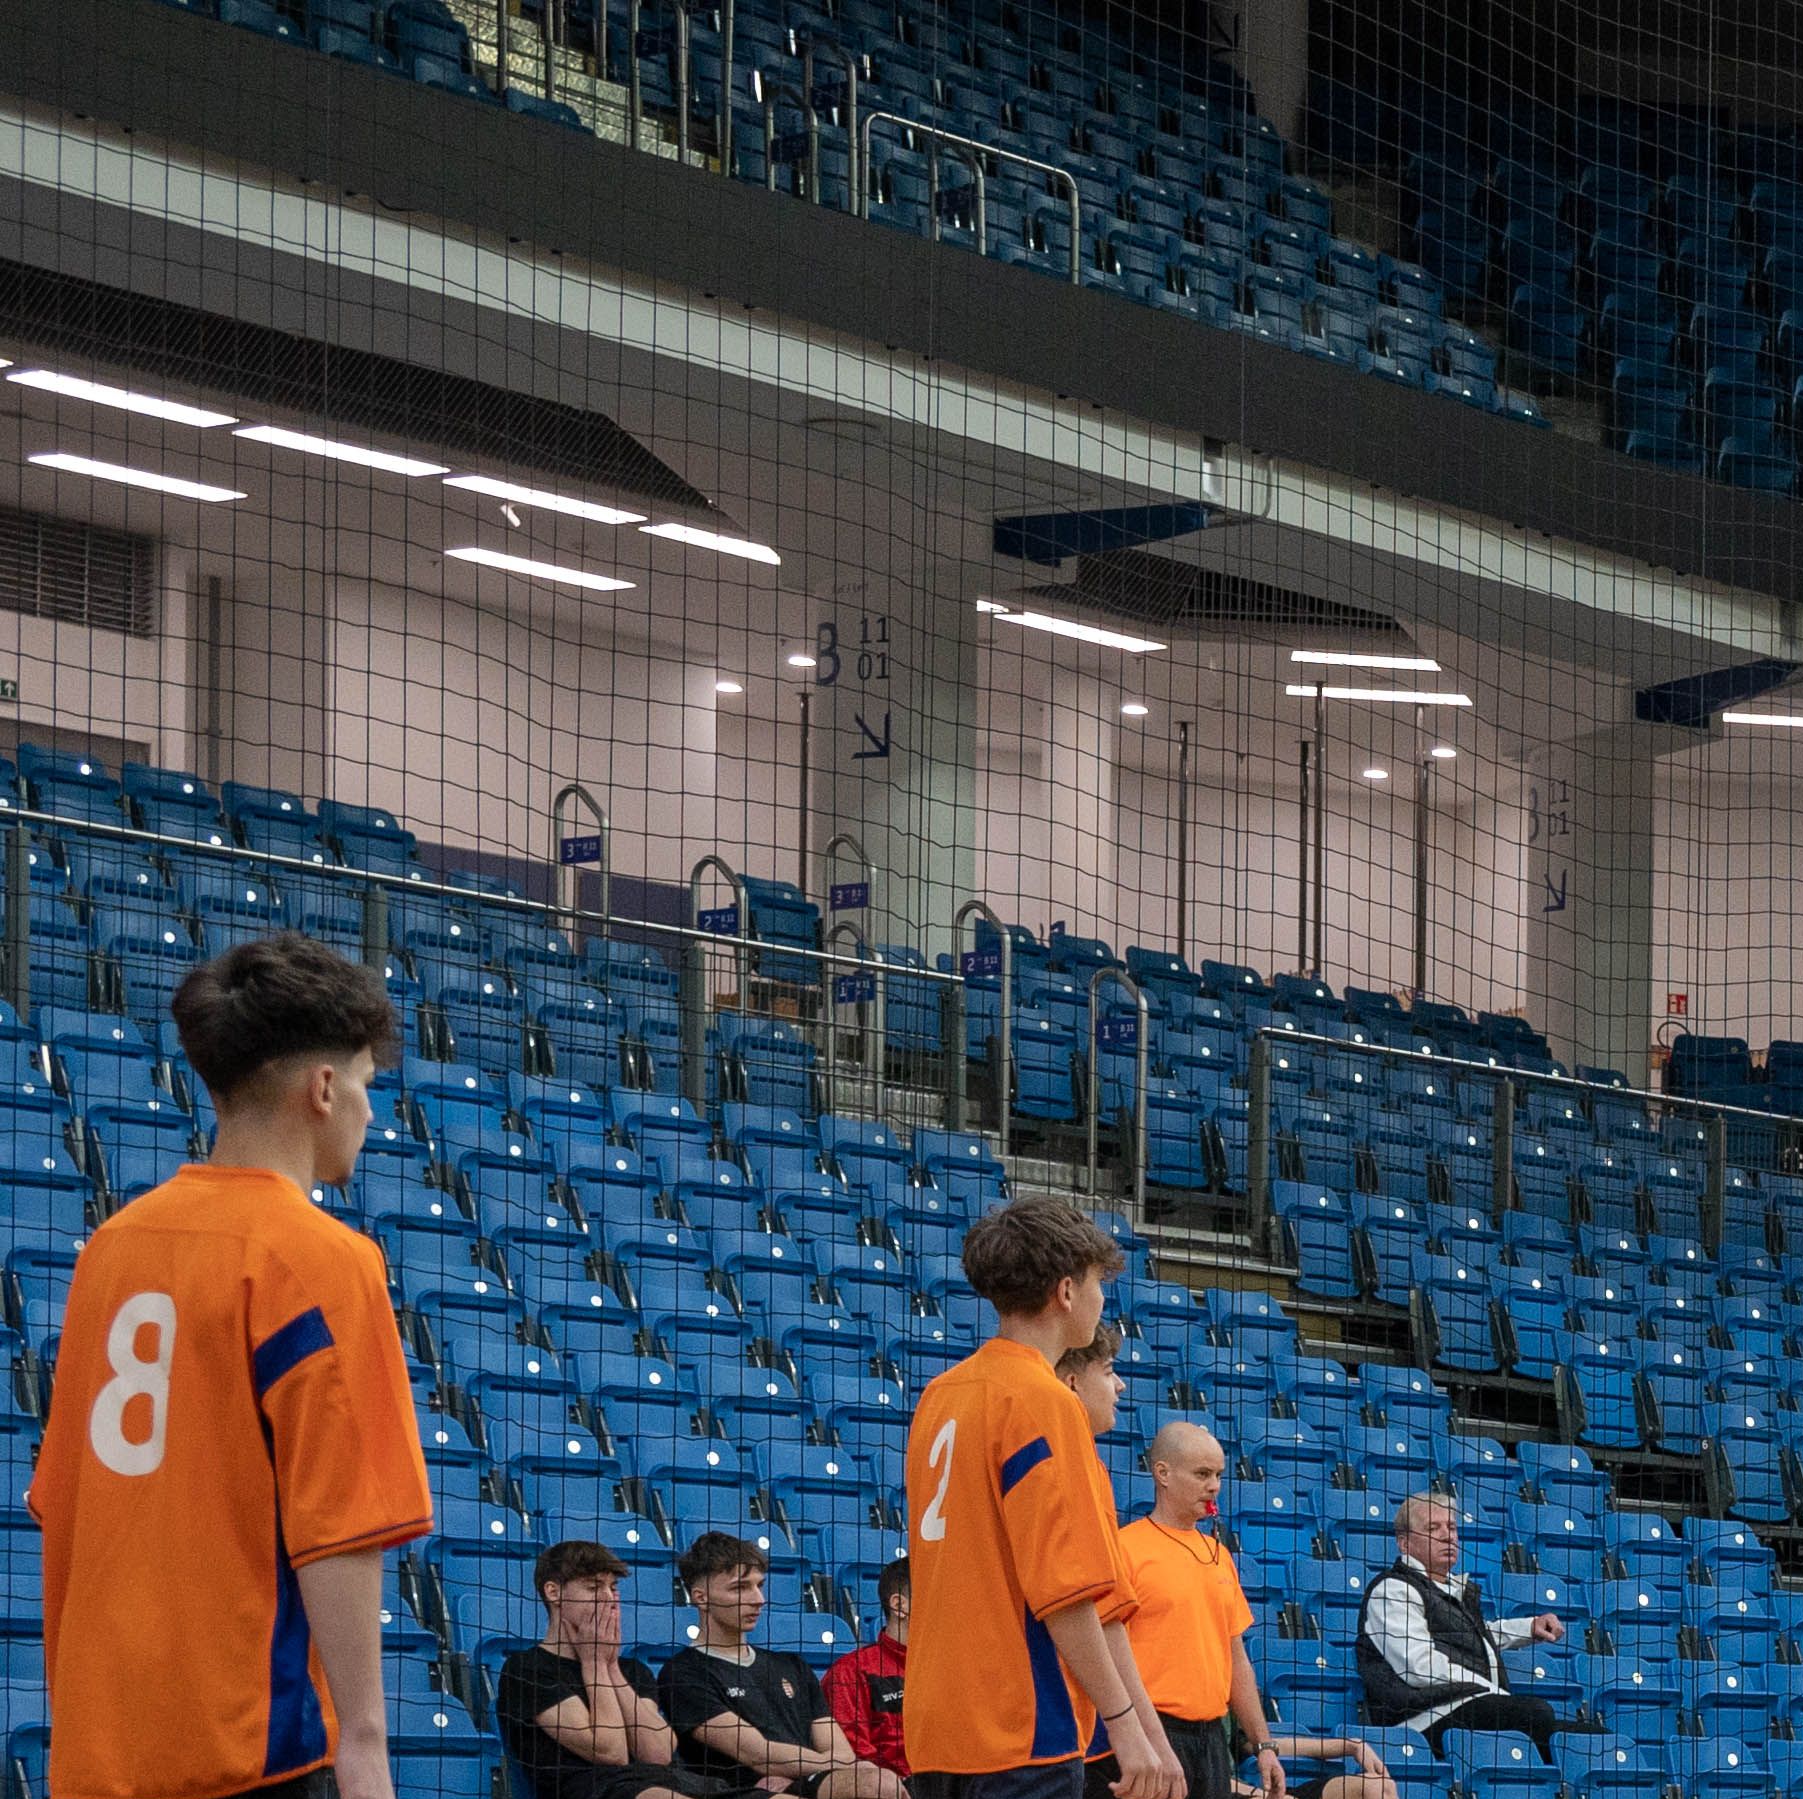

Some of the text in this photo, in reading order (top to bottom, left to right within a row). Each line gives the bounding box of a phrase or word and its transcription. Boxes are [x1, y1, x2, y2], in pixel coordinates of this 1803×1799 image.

[860, 617, 889, 643] 11
[817, 622, 841, 686] B
[858, 652, 889, 680] 01
[967, 957, 975, 972] 2
[1103, 1025, 1111, 1039] 1
[89, 1292, 176, 1477] 8
[920, 1418, 955, 1542] 2
